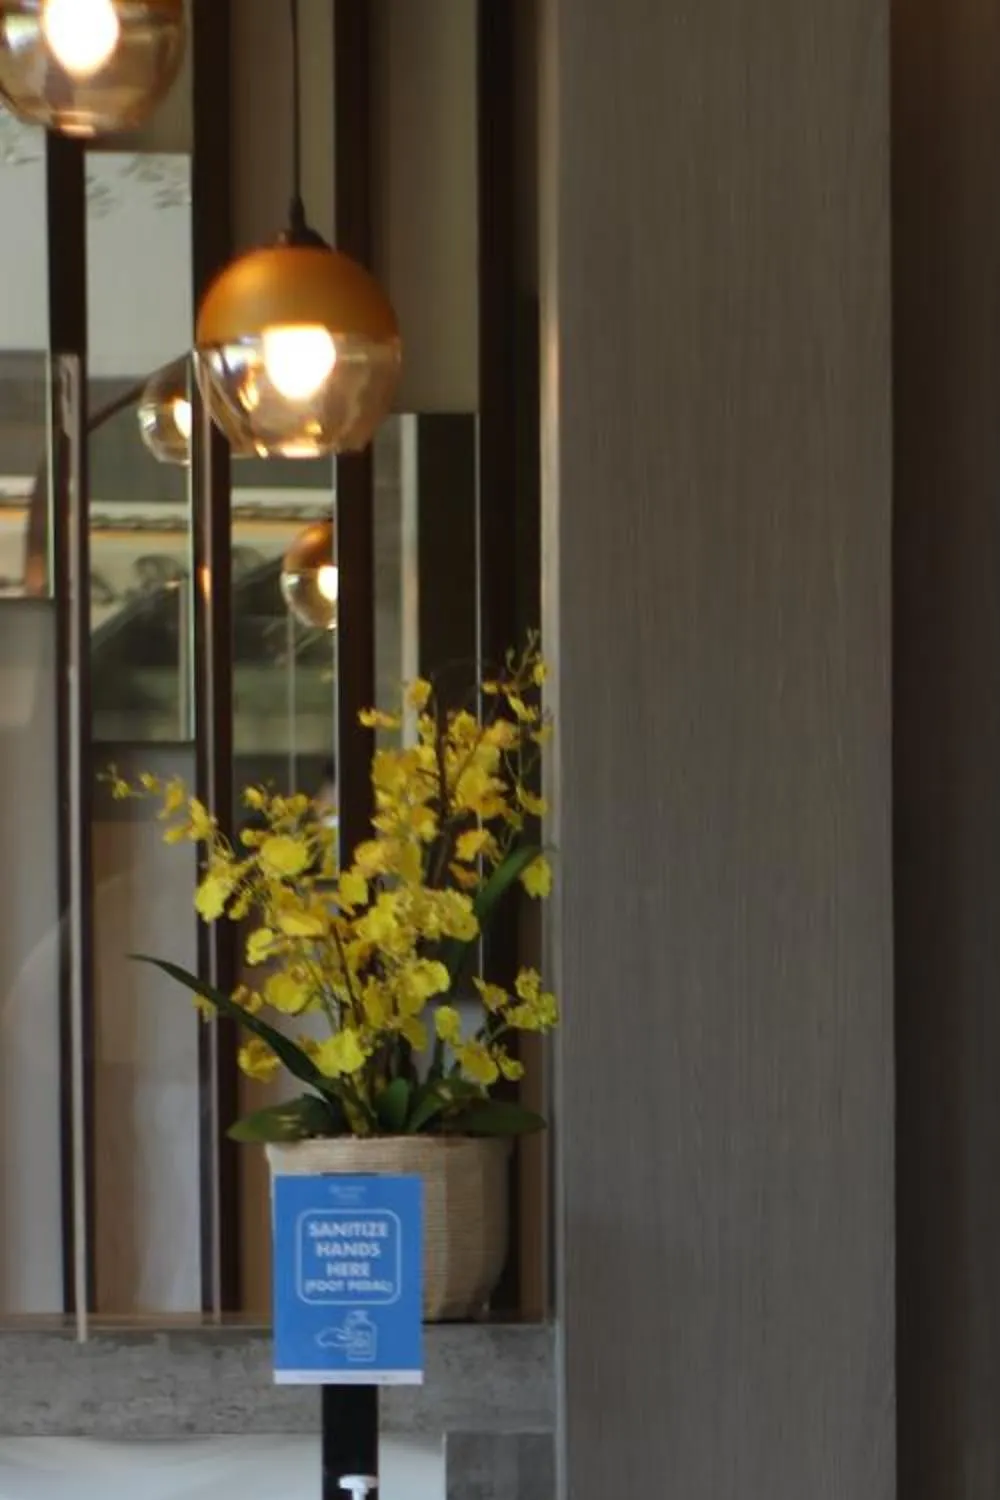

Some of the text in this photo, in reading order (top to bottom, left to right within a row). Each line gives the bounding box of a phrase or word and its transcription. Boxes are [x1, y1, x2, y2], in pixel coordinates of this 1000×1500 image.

[308, 1221, 388, 1237] SANITIZE
[316, 1241, 381, 1257] HANDS
[326, 1262, 370, 1277] HERE
